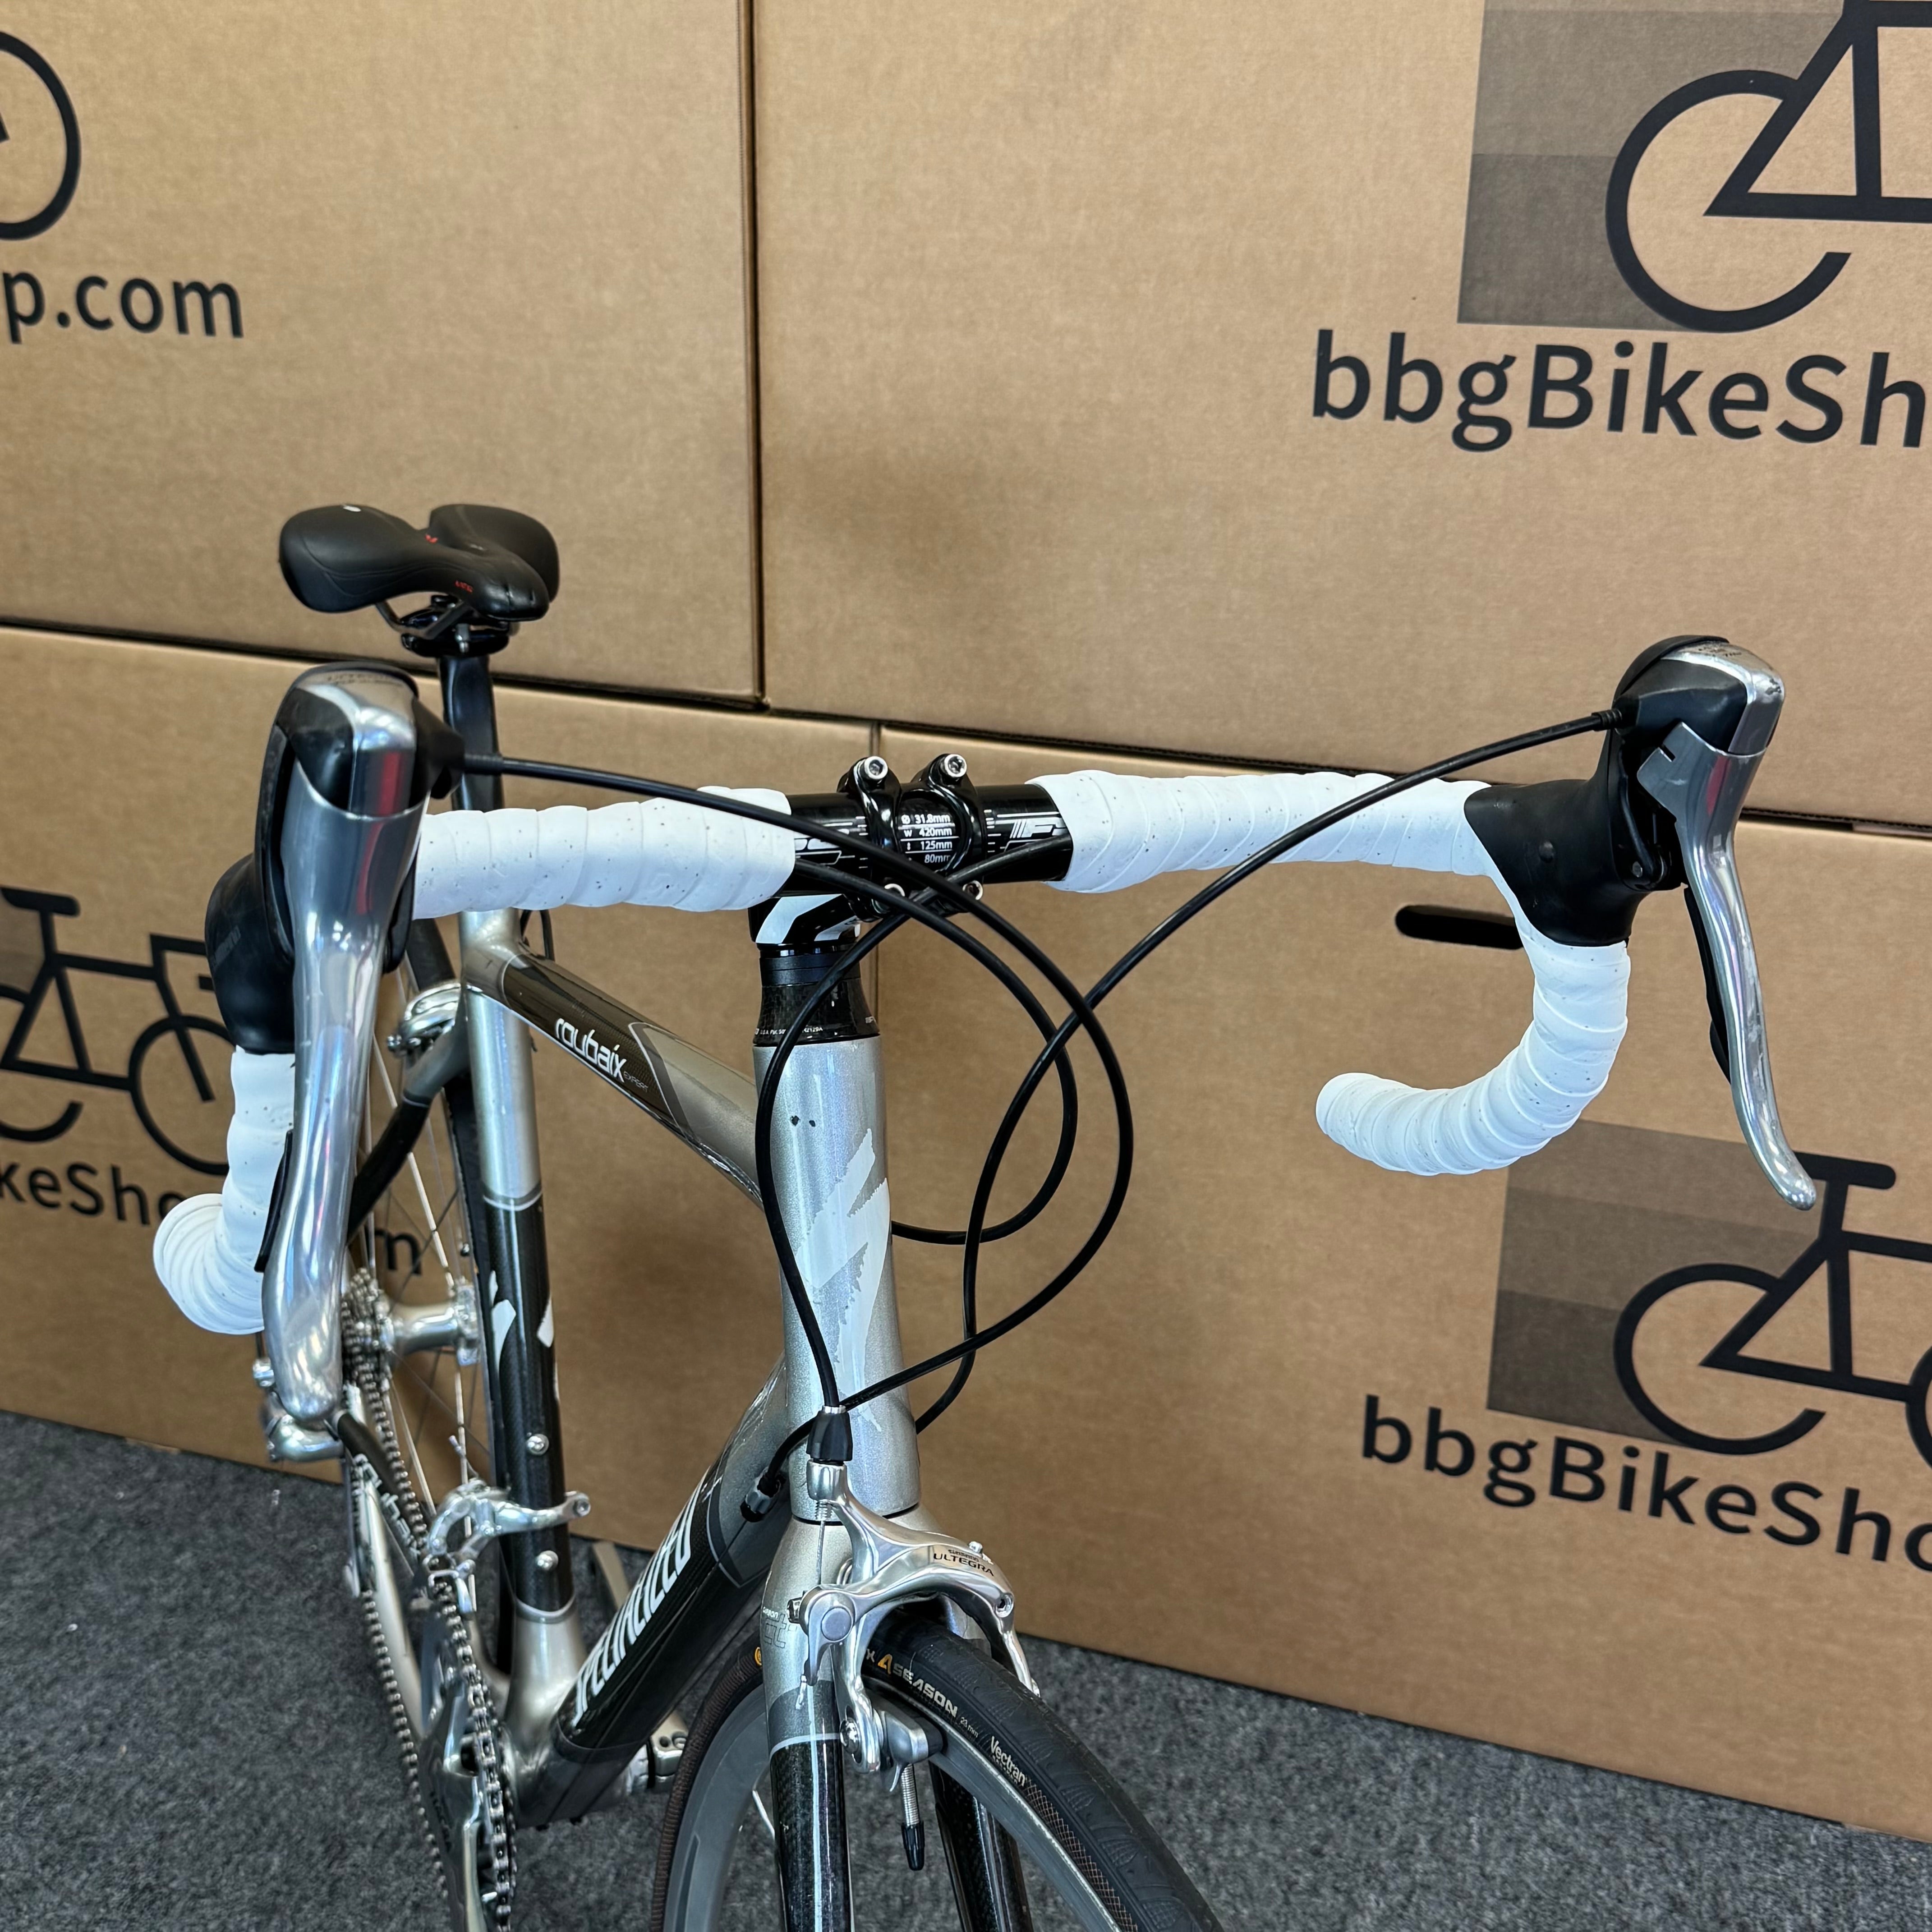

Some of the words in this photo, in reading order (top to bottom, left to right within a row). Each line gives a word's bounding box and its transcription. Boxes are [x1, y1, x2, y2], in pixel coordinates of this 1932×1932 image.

[1312, 328, 1926, 453] bbgBikeSh
[915, 814, 951, 824] 31.8mm
[919, 828, 952, 837] 420mm
[920, 841, 952, 850] 125mm
[555, 1018, 627, 1083] roubaix
[934, 1553, 994, 1576] ULTEGRA
[893, 1663, 958, 1717] SEASON
[991, 1735, 1026, 1787] Vectran
